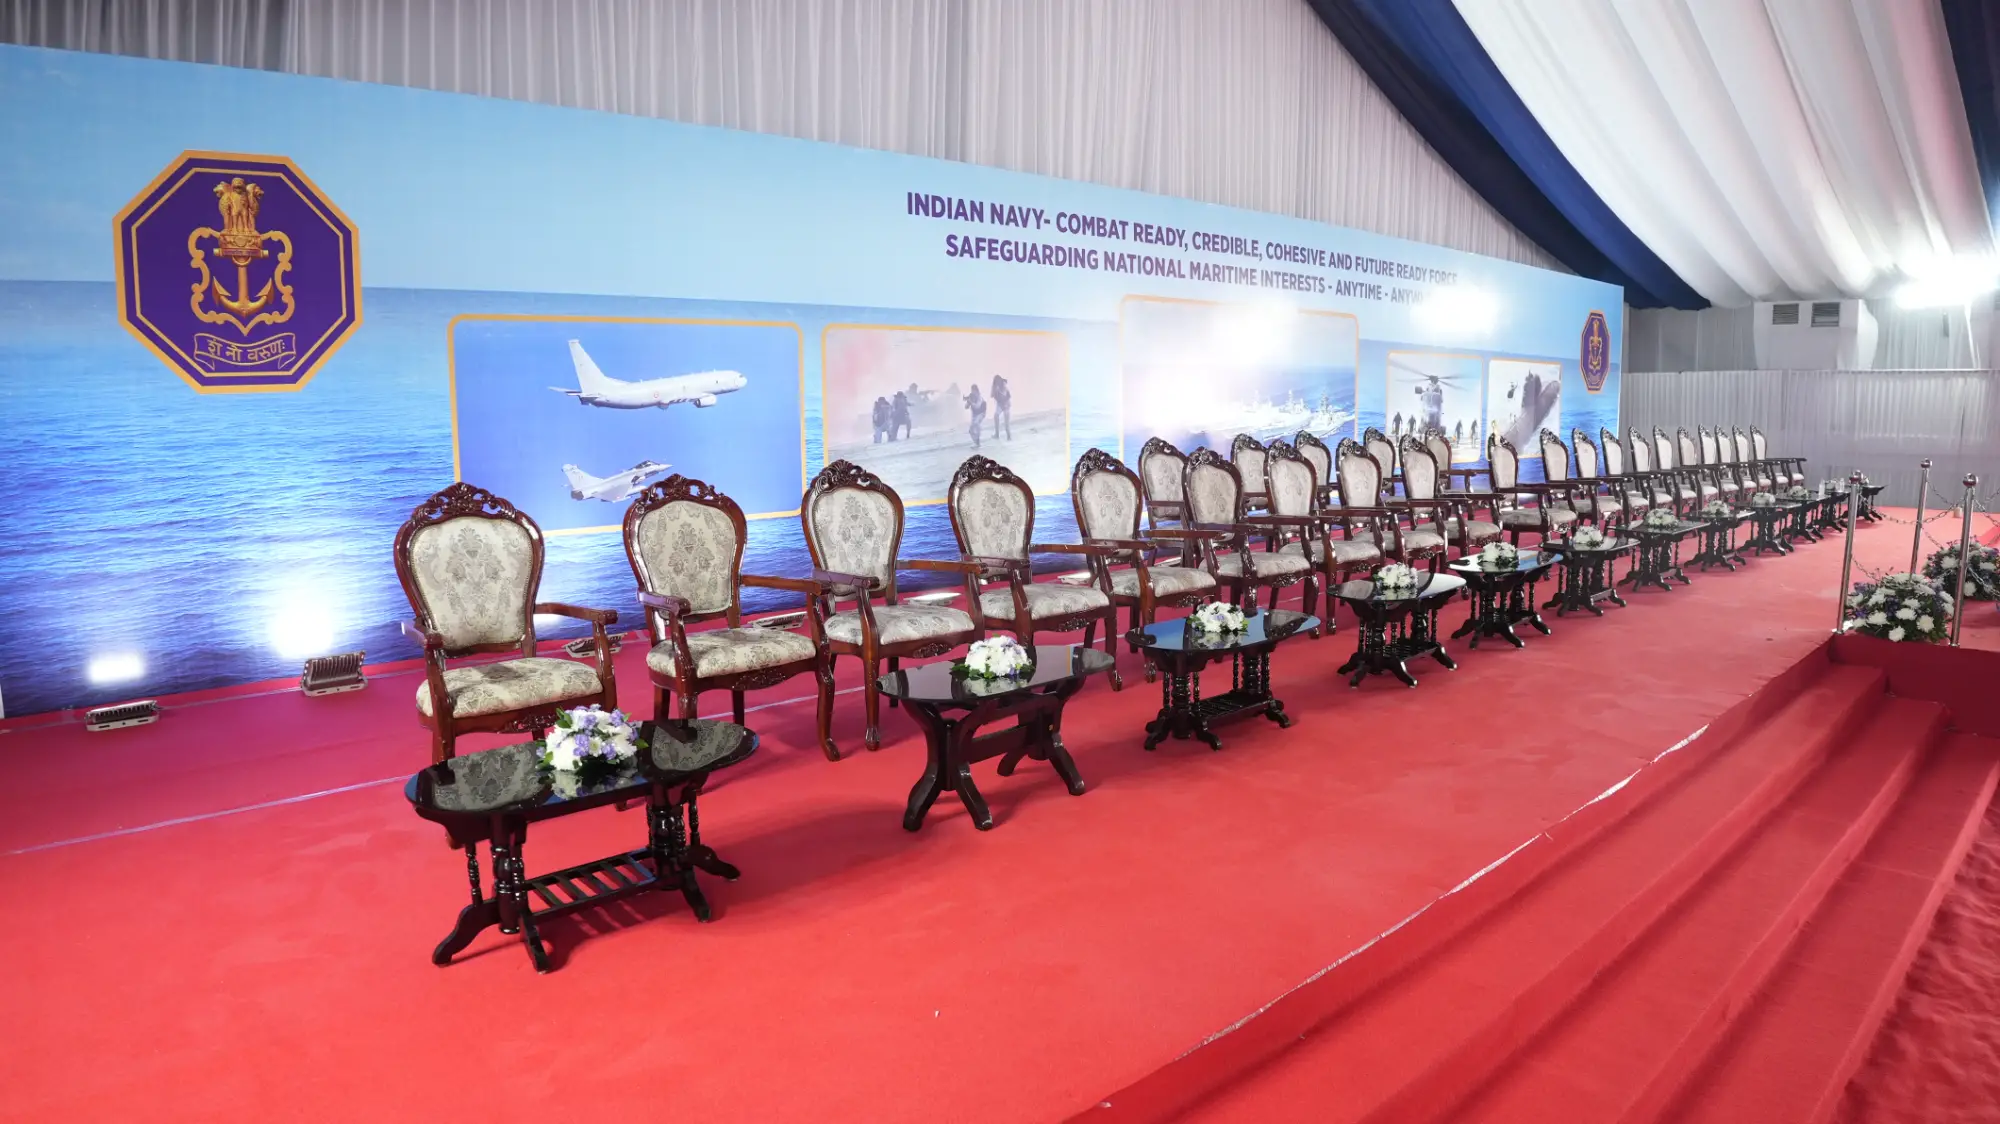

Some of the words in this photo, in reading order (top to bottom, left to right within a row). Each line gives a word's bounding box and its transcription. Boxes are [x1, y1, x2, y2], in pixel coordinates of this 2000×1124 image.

[907, 191, 984, 223] INDIAN
[990, 203, 1051, 230] NAVY-
[1056, 212, 1129, 240] COMBAT
[1133, 224, 1188, 252] READY,
[1192, 231, 1263, 261] CREDIBLE,
[1265, 242, 1326, 267] COHESIVE
[1328, 252, 1352, 271] AND
[1355, 256, 1395, 277] FUTURE
[1396, 263, 1427, 282] READY
[945, 234, 1098, 270] SAFEGUARDING
[1104, 251, 1186, 279] NATIONAL
[1190, 261, 1258, 286] MARITIME
[1261, 269, 1325, 294] INTERESTS
[1335, 279, 1382, 301] ANYTIME
